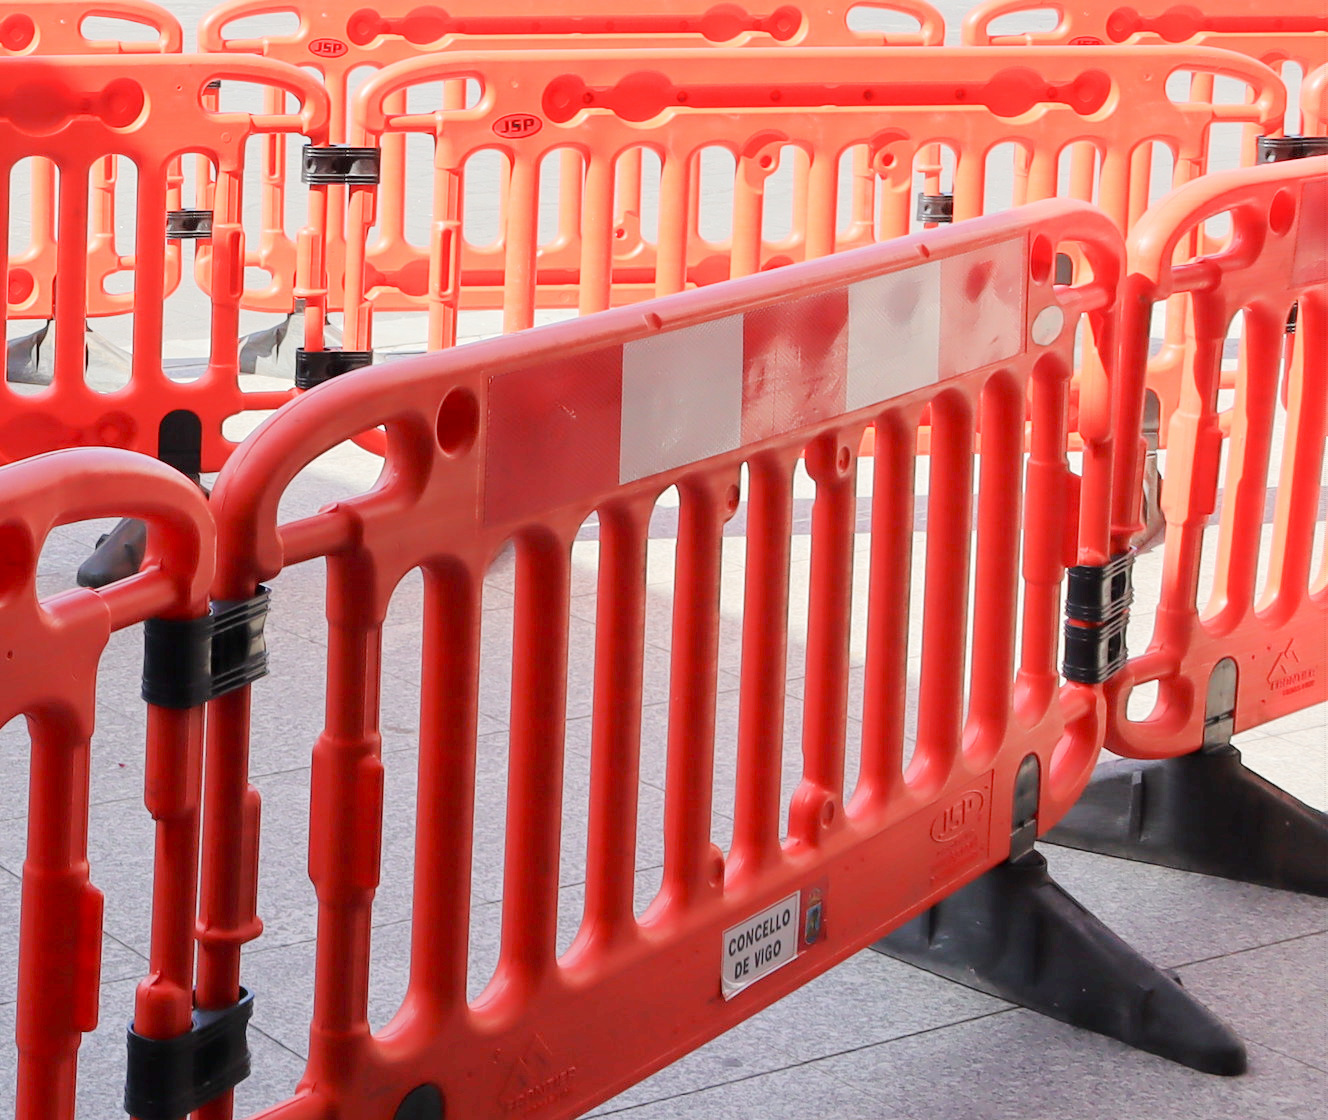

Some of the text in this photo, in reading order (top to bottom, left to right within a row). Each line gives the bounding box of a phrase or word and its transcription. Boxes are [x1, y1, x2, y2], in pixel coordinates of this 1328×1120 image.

[314, 42, 343, 53] JSP
[500, 118, 534, 133] JSP
[728, 908, 791, 957] CONCELLO
[734, 940, 782, 980] DE VIGO
